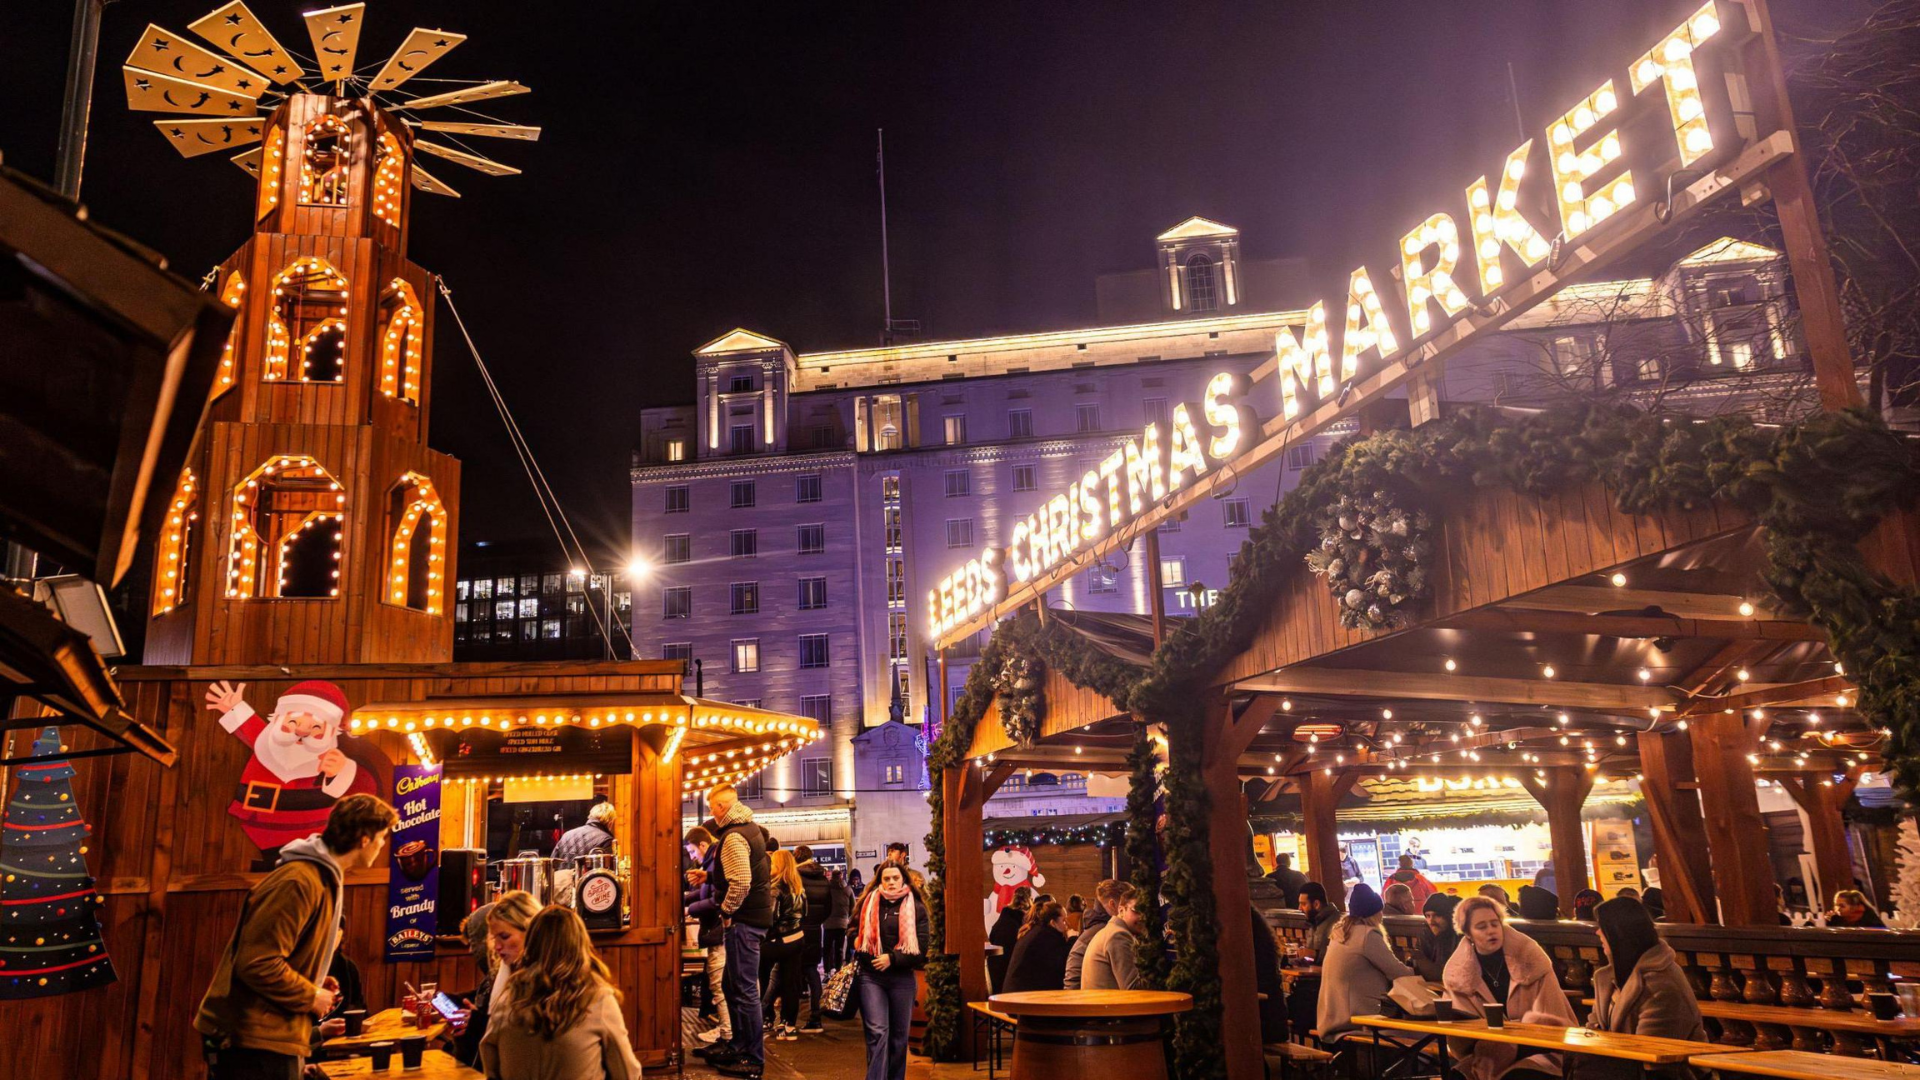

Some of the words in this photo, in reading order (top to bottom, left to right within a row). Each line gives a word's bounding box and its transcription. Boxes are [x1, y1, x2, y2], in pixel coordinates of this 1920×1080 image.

[928, 547, 997, 640] LEEDS
[1011, 372, 1240, 583] CHRISTMAS
[1275, 0, 1722, 421] MARKET
[1175, 589, 1218, 609] THE
[403, 798, 427, 816] Hot
[392, 809, 441, 833] Chocolate
[400, 884, 424, 894] served
[405, 893, 421, 901] with
[390, 899, 436, 919] Brandy
[391, 930, 430, 944] BAILEYS
